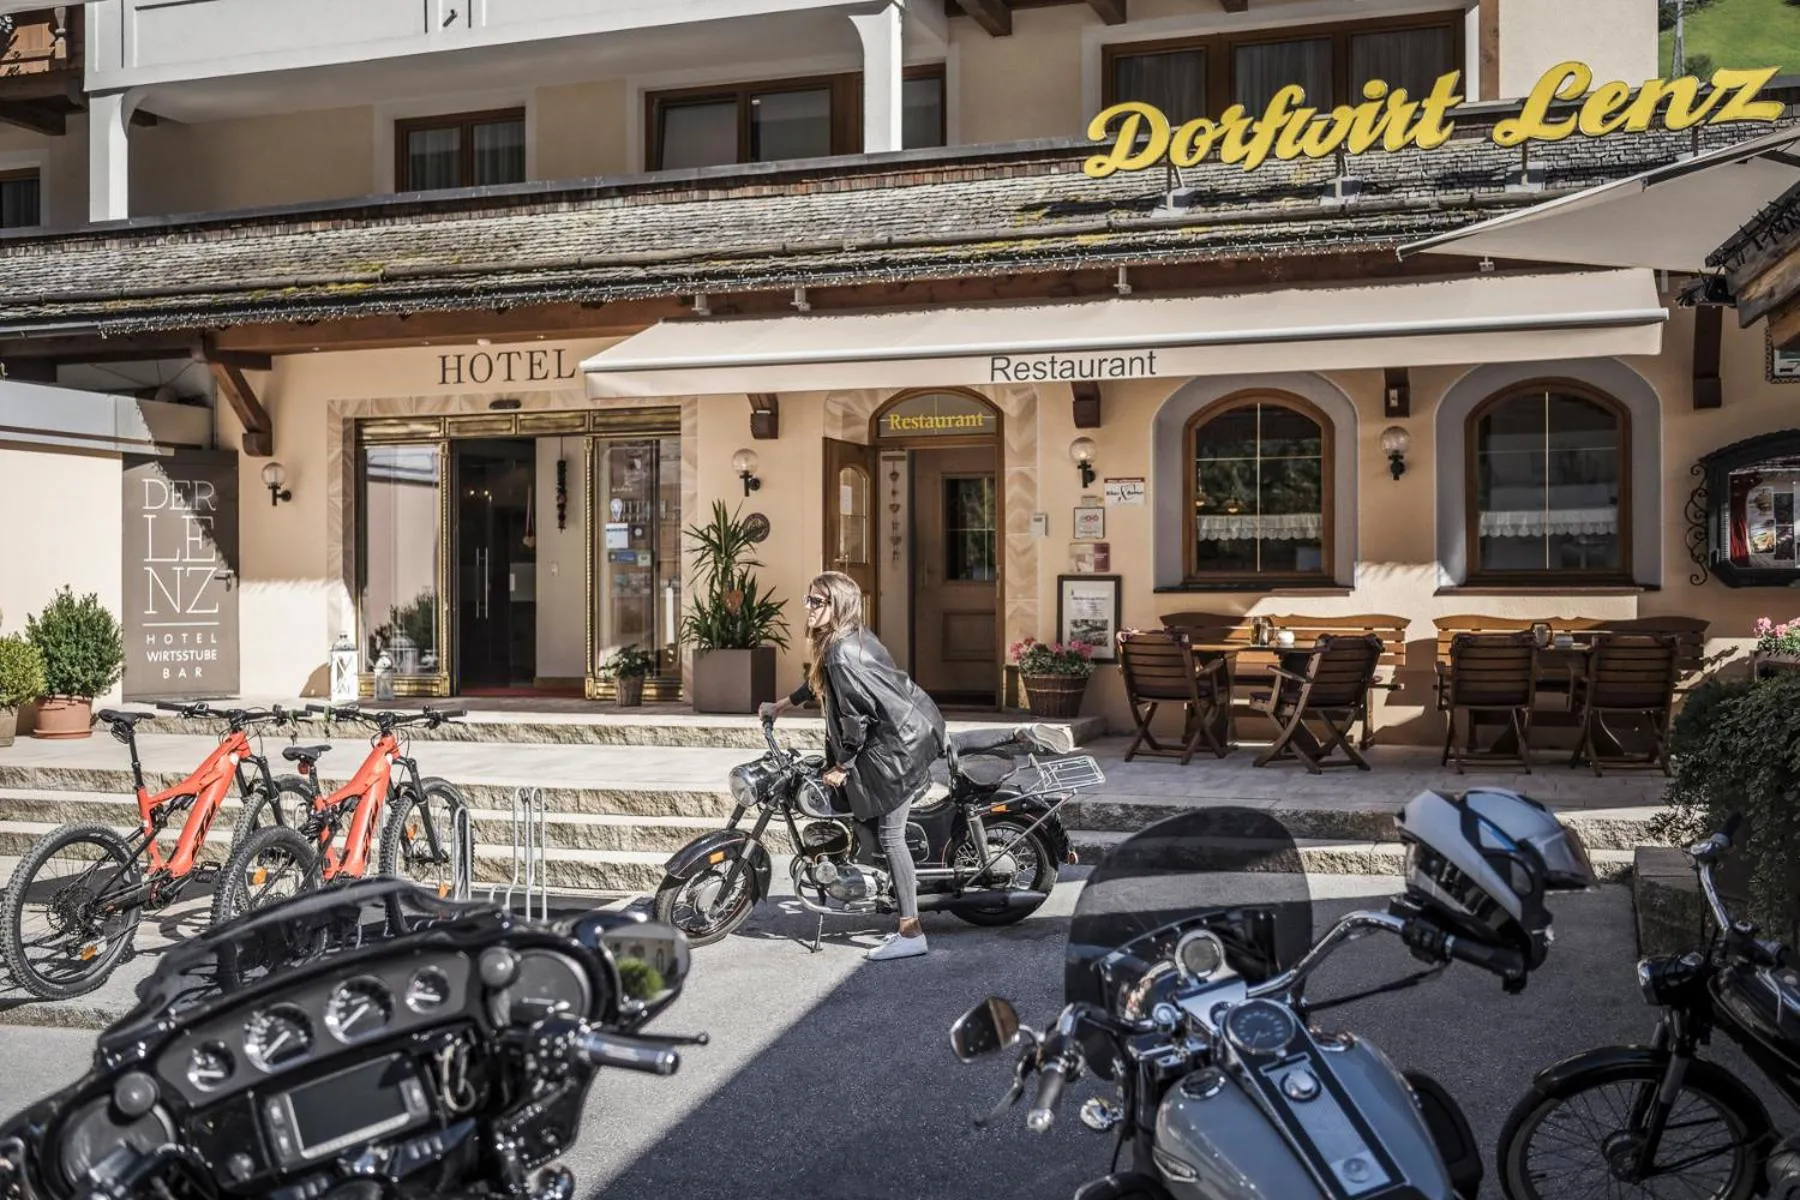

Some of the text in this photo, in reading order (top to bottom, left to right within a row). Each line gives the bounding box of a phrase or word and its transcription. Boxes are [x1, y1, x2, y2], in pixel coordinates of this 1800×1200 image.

[1083, 60, 1786, 179] Dorfwirt Lenz
[437, 348, 577, 385] HOTEL
[990, 350, 1157, 382] Restaurant
[888, 412, 985, 431] Restaurant
[142, 478, 217, 511] DER
[142, 514, 217, 563] LE
[143, 566, 219, 614] NZ
[146, 631, 217, 646] HOTEL
[146, 648, 217, 663] WIRTSSTUBE
[162, 666, 203, 680] BAR
